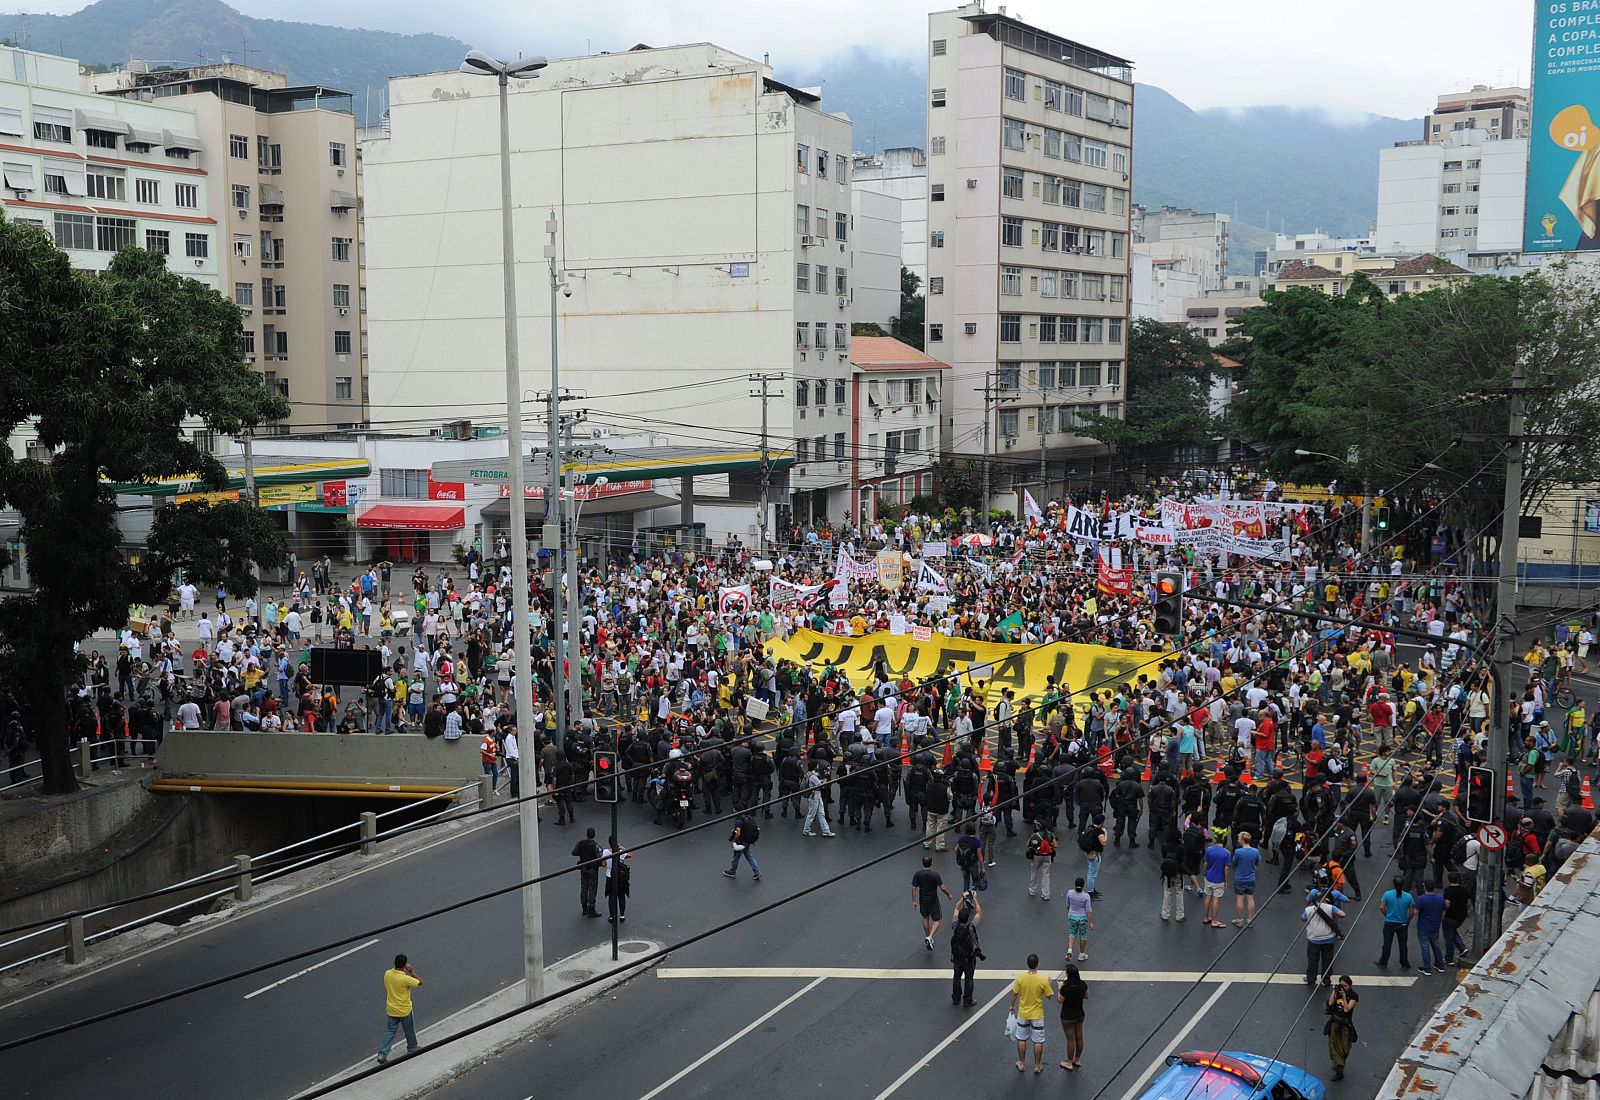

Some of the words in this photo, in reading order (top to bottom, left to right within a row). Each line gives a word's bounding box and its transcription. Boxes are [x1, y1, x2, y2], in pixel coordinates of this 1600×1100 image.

[1550, 3, 1567, 14] OS
[1572, 0, 1600, 12] BRA
[1548, 33, 1557, 44] A
[1563, 125, 1587, 148] oi
[470, 469, 509, 479] PETROBRA
[1069, 510, 1127, 540] ANEL
[1129, 514, 1164, 529] FORA
[1135, 527, 1172, 543] CABRAL
